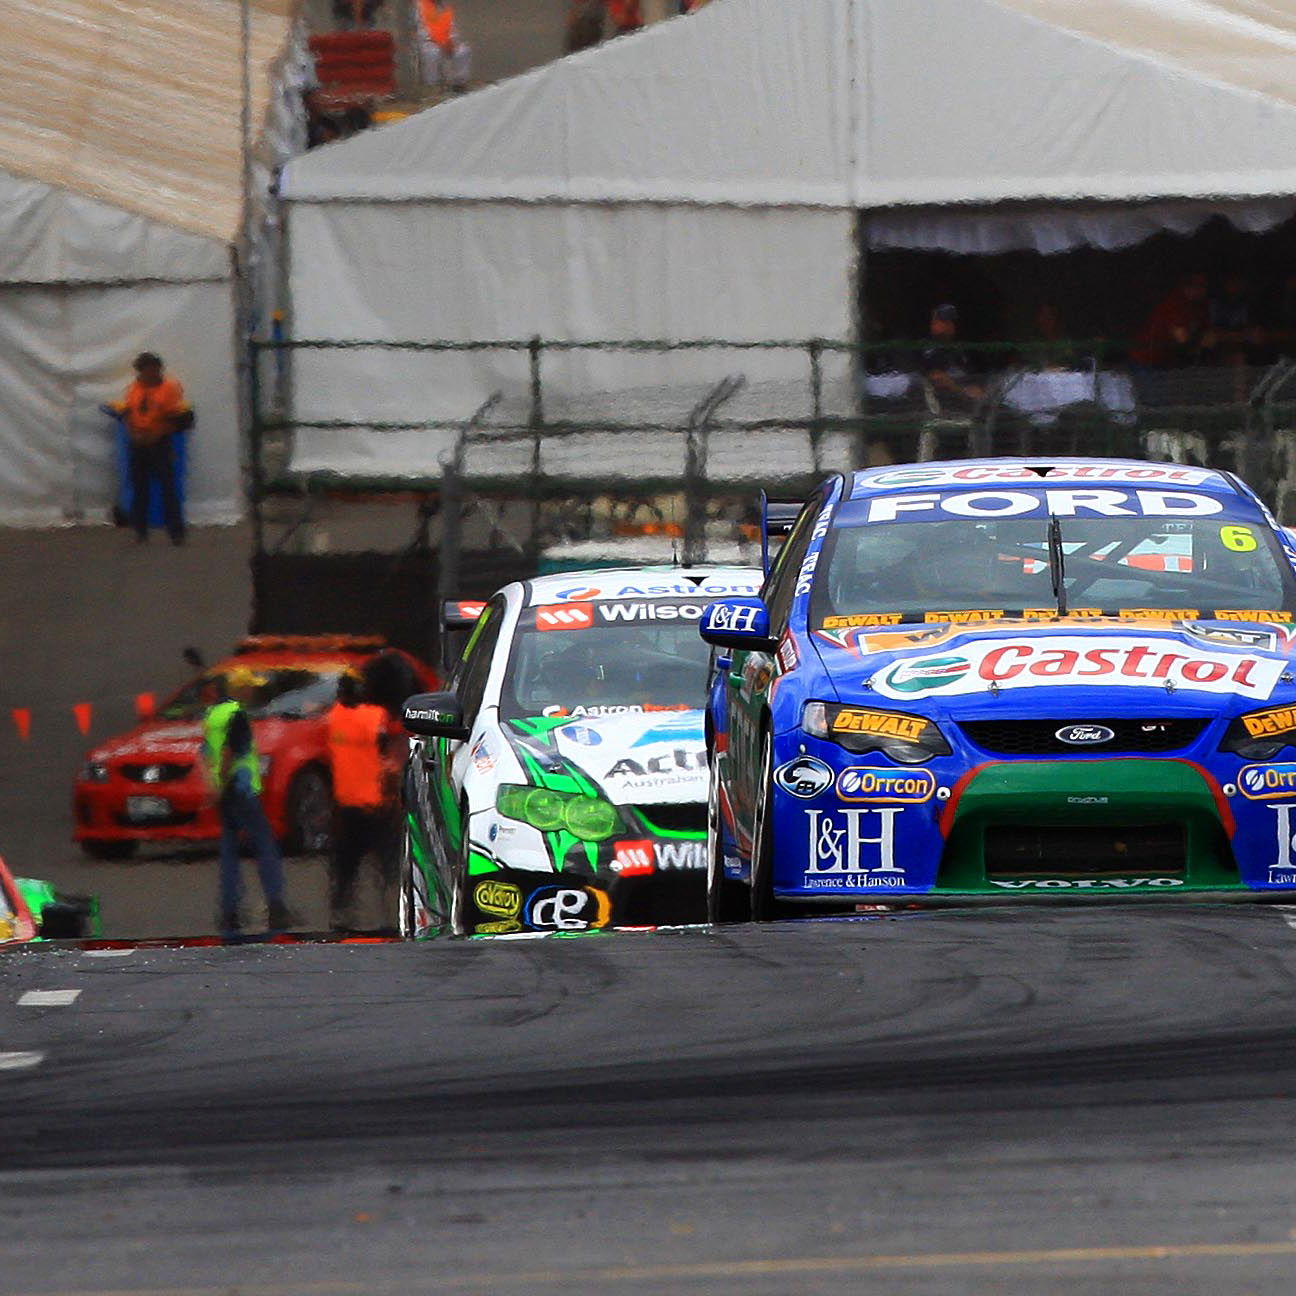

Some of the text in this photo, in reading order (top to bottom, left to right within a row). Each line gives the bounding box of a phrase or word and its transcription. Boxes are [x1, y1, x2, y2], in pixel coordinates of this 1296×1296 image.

[867, 488, 1224, 523] FORD
[1219, 525, 1258, 553] 6
[599, 603, 705, 621] Wilso
[706, 603, 762, 633] L&H
[979, 645, 1258, 688] Castrol
[405, 708, 455, 722] hamilton
[1069, 727, 1102, 740] Ford
[861, 773, 927, 794] Orrcon
[990, 878, 1184, 888] VOLVO
